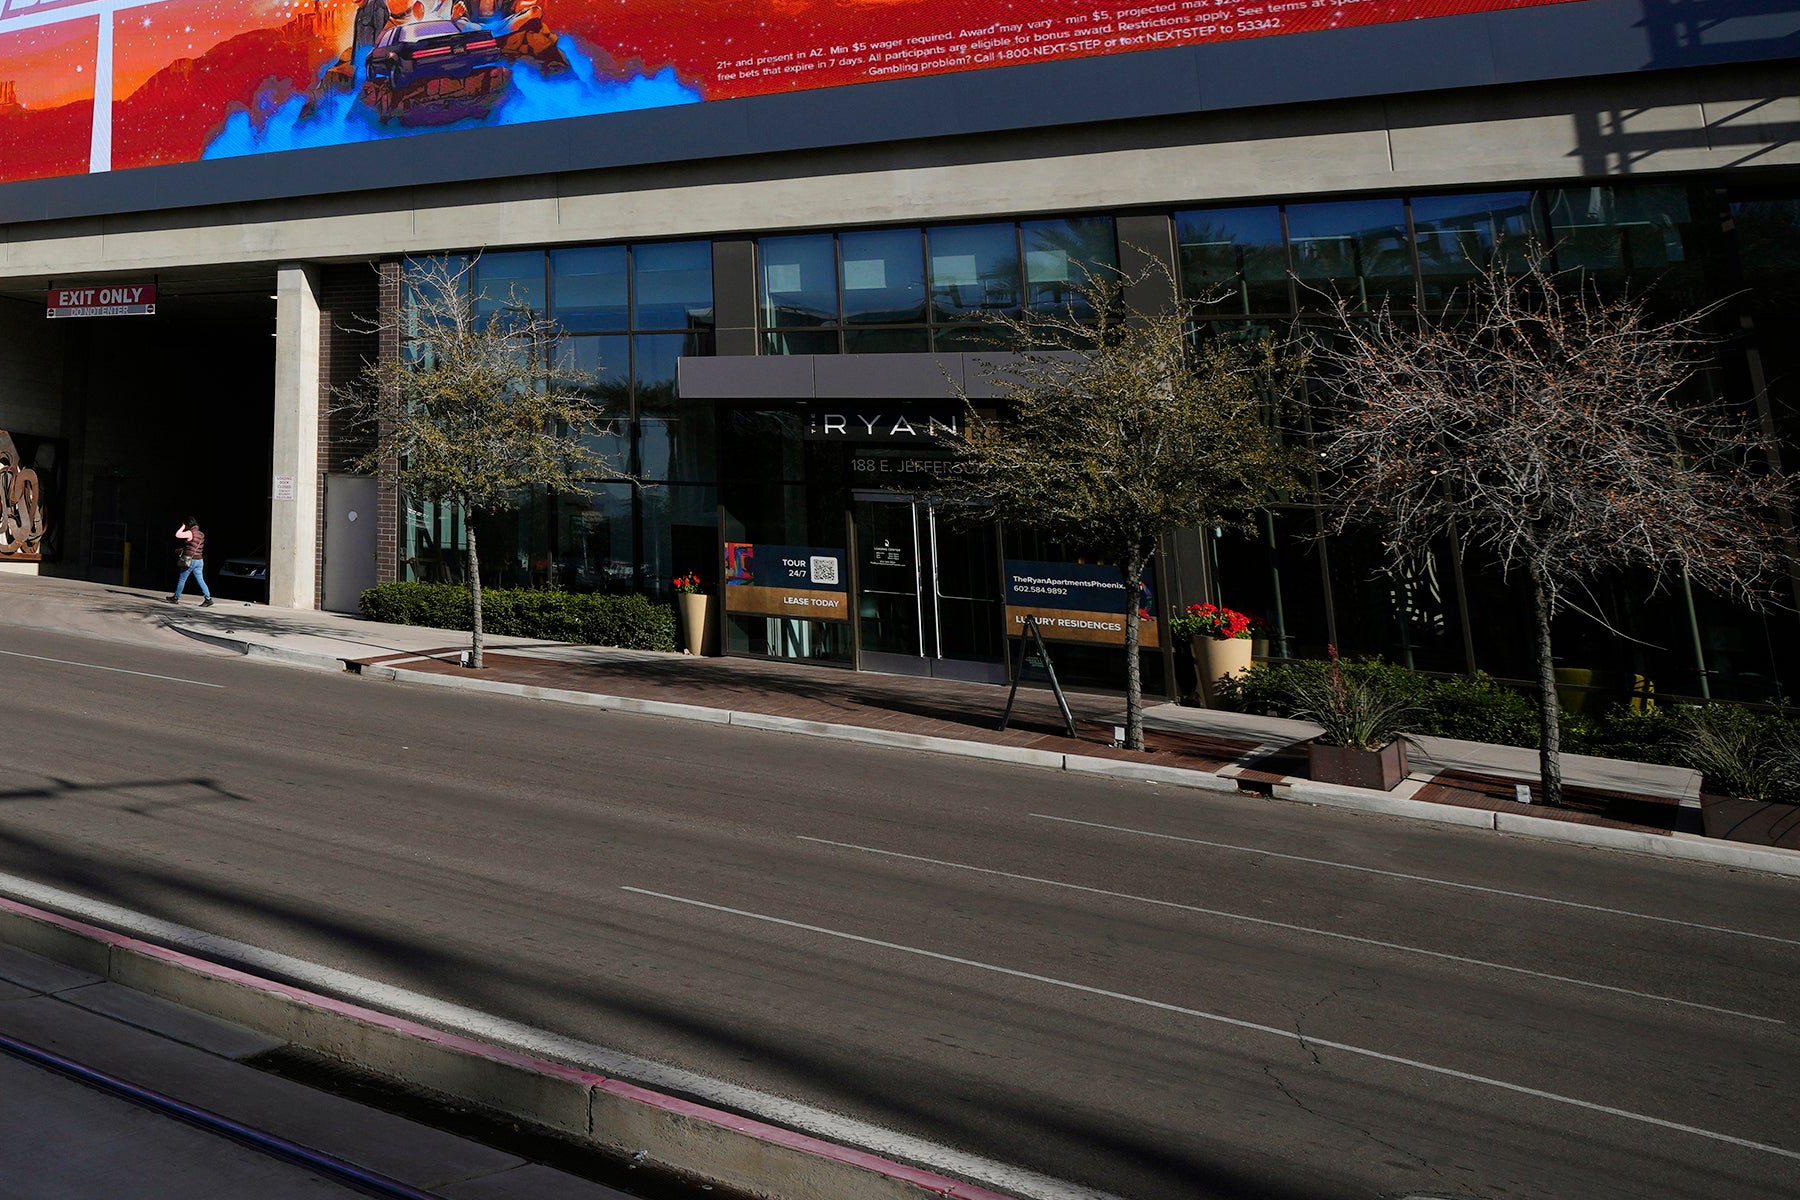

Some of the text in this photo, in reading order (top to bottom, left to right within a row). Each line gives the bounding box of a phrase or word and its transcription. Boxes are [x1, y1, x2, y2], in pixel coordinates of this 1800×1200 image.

[716, 59, 733, 70] 21+
[735, 57, 753, 68] and
[756, 53, 793, 66] present
[796, 51, 806, 59] in
[809, 48, 827, 58] AZ.
[830, 45, 849, 56] Min
[852, 42, 867, 52] $5
[870, 39, 902, 51] wager
[906, 31, 956, 47] required.
[1000, 22, 1023, 33] may
[1027, 19, 1052, 30] vary
[1065, 14, 1087, 24] min
[1117, 2, 1176, 19] projected
[1181, 0, 1208, 9] max
[717, 71, 736, 81] free
[739, 68, 760, 80] bets
[762, 65, 781, 76] that
[784, 61, 815, 75] expire
[817, 59, 827, 68] in
[829, 58, 836, 67] 7
[839, 55, 866, 68] days.
[868, 52, 882, 62] All
[885, 45, 945, 63] participants
[949, 42, 967, 52] are
[970, 36, 1011, 52] eligible
[1014, 34, 1030, 44] for
[1033, 29, 1071, 43] bonus
[1118, 15, 1191, 32] Restrictions
[1194, 9, 1233, 24] apply.
[1237, 6, 1263, 17] See
[1267, 0, 1307, 13] terms
[868, 62, 918, 76] Gambling
[920, 56, 970, 71] problem?
[974, 51, 995, 63] Call
[997, 39, 1100, 60] 1-800-NEXT-STEP
[1104, 39, 1117, 48] or
[1119, 35, 1144, 46] text
[1146, 25, 1216, 42] NEXTSTEP
[1220, 24, 1233, 34] to
[59, 287, 143, 306] EXIT ONLY
[70, 306, 128, 316] DO NOT ENTER
[824, 414, 957, 436] RYAN
[851, 459, 875, 472] 188
[880, 460, 893, 472] E.
[782, 559, 806, 567] TOUR
[788, 569, 806, 577] 24/7
[1013, 576, 1126, 590] TheRyanApartmentsPhoenix.
[1013, 585, 1068, 595] 602.584.9892
[783, 596, 839, 607] LEASE TODAY
[1016, 615, 1121, 631] LUURY RESIDENCES
